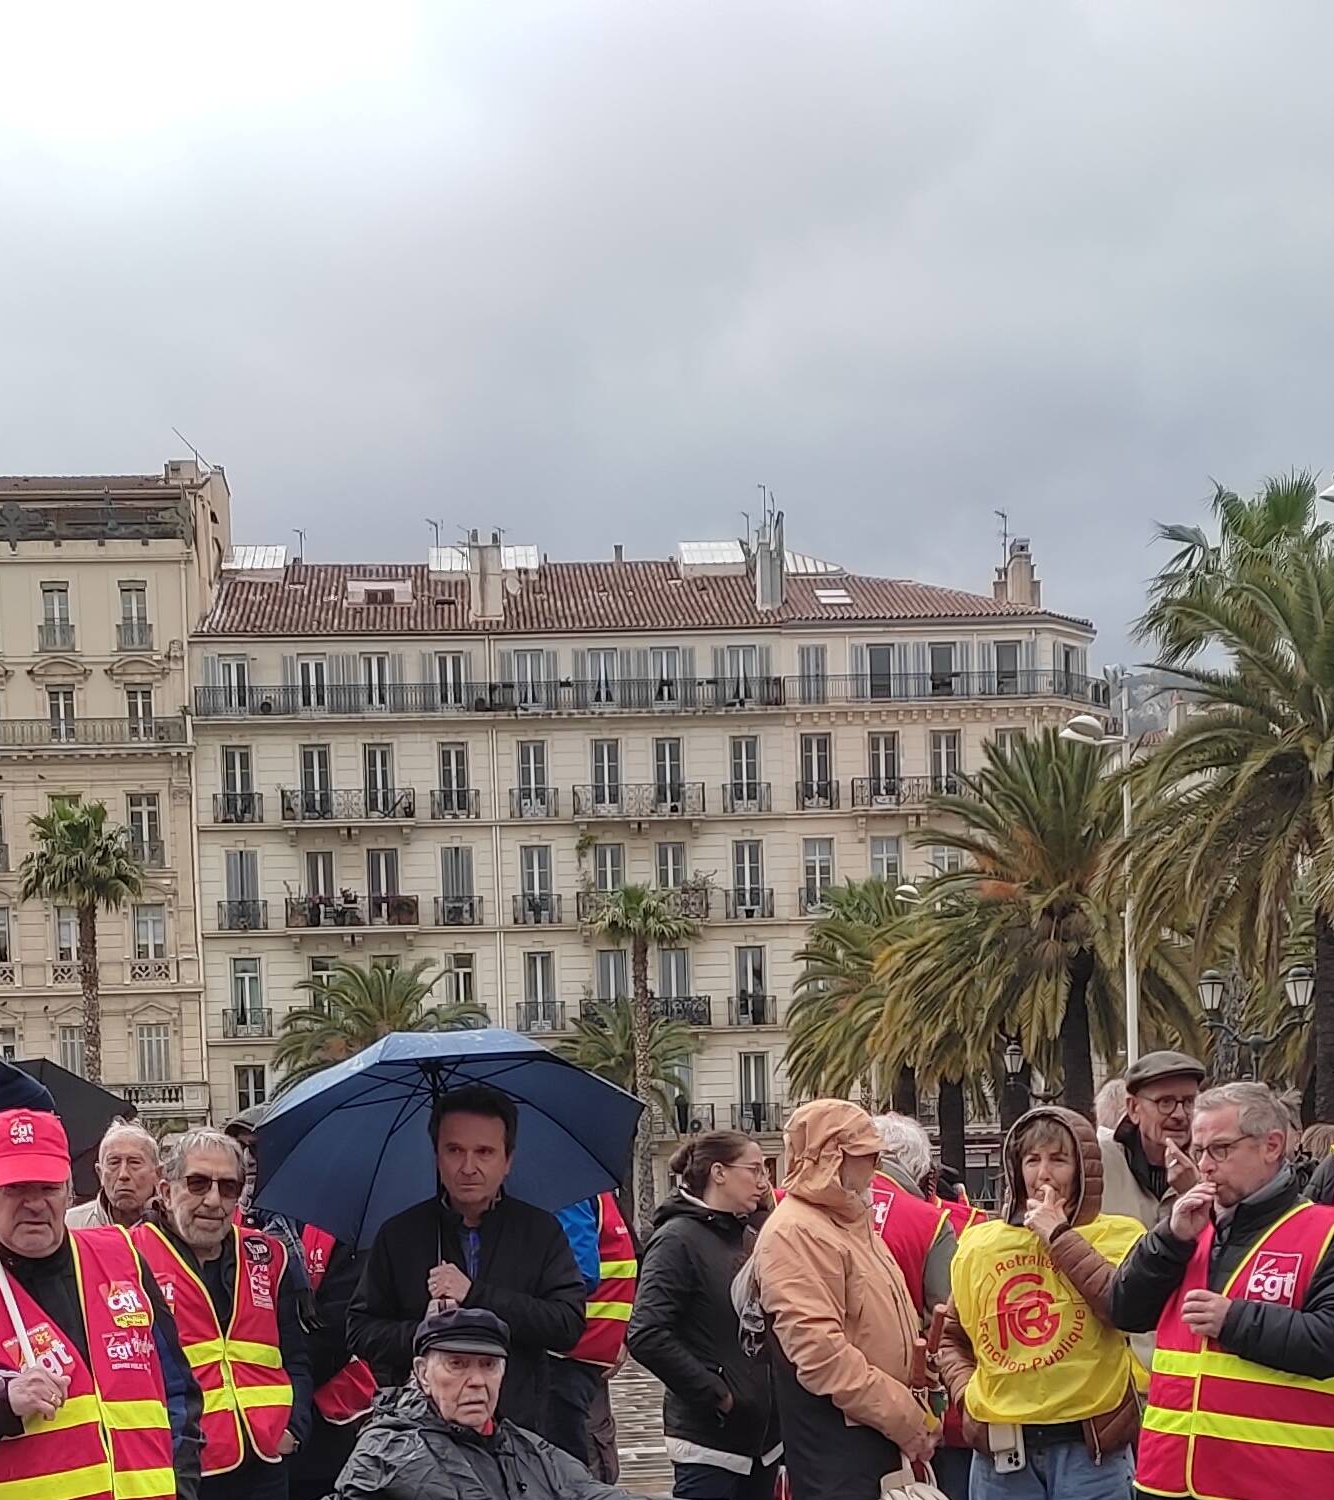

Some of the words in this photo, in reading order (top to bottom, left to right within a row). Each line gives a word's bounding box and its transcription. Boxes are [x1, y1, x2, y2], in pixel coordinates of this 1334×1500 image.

[10, 1122, 34, 1138] cgt
[1249, 1271, 1296, 1300] cgt
[106, 1289, 143, 1314] cgt
[107, 1341, 134, 1361] cgt
[1031, 1308, 1085, 1371] Publique
